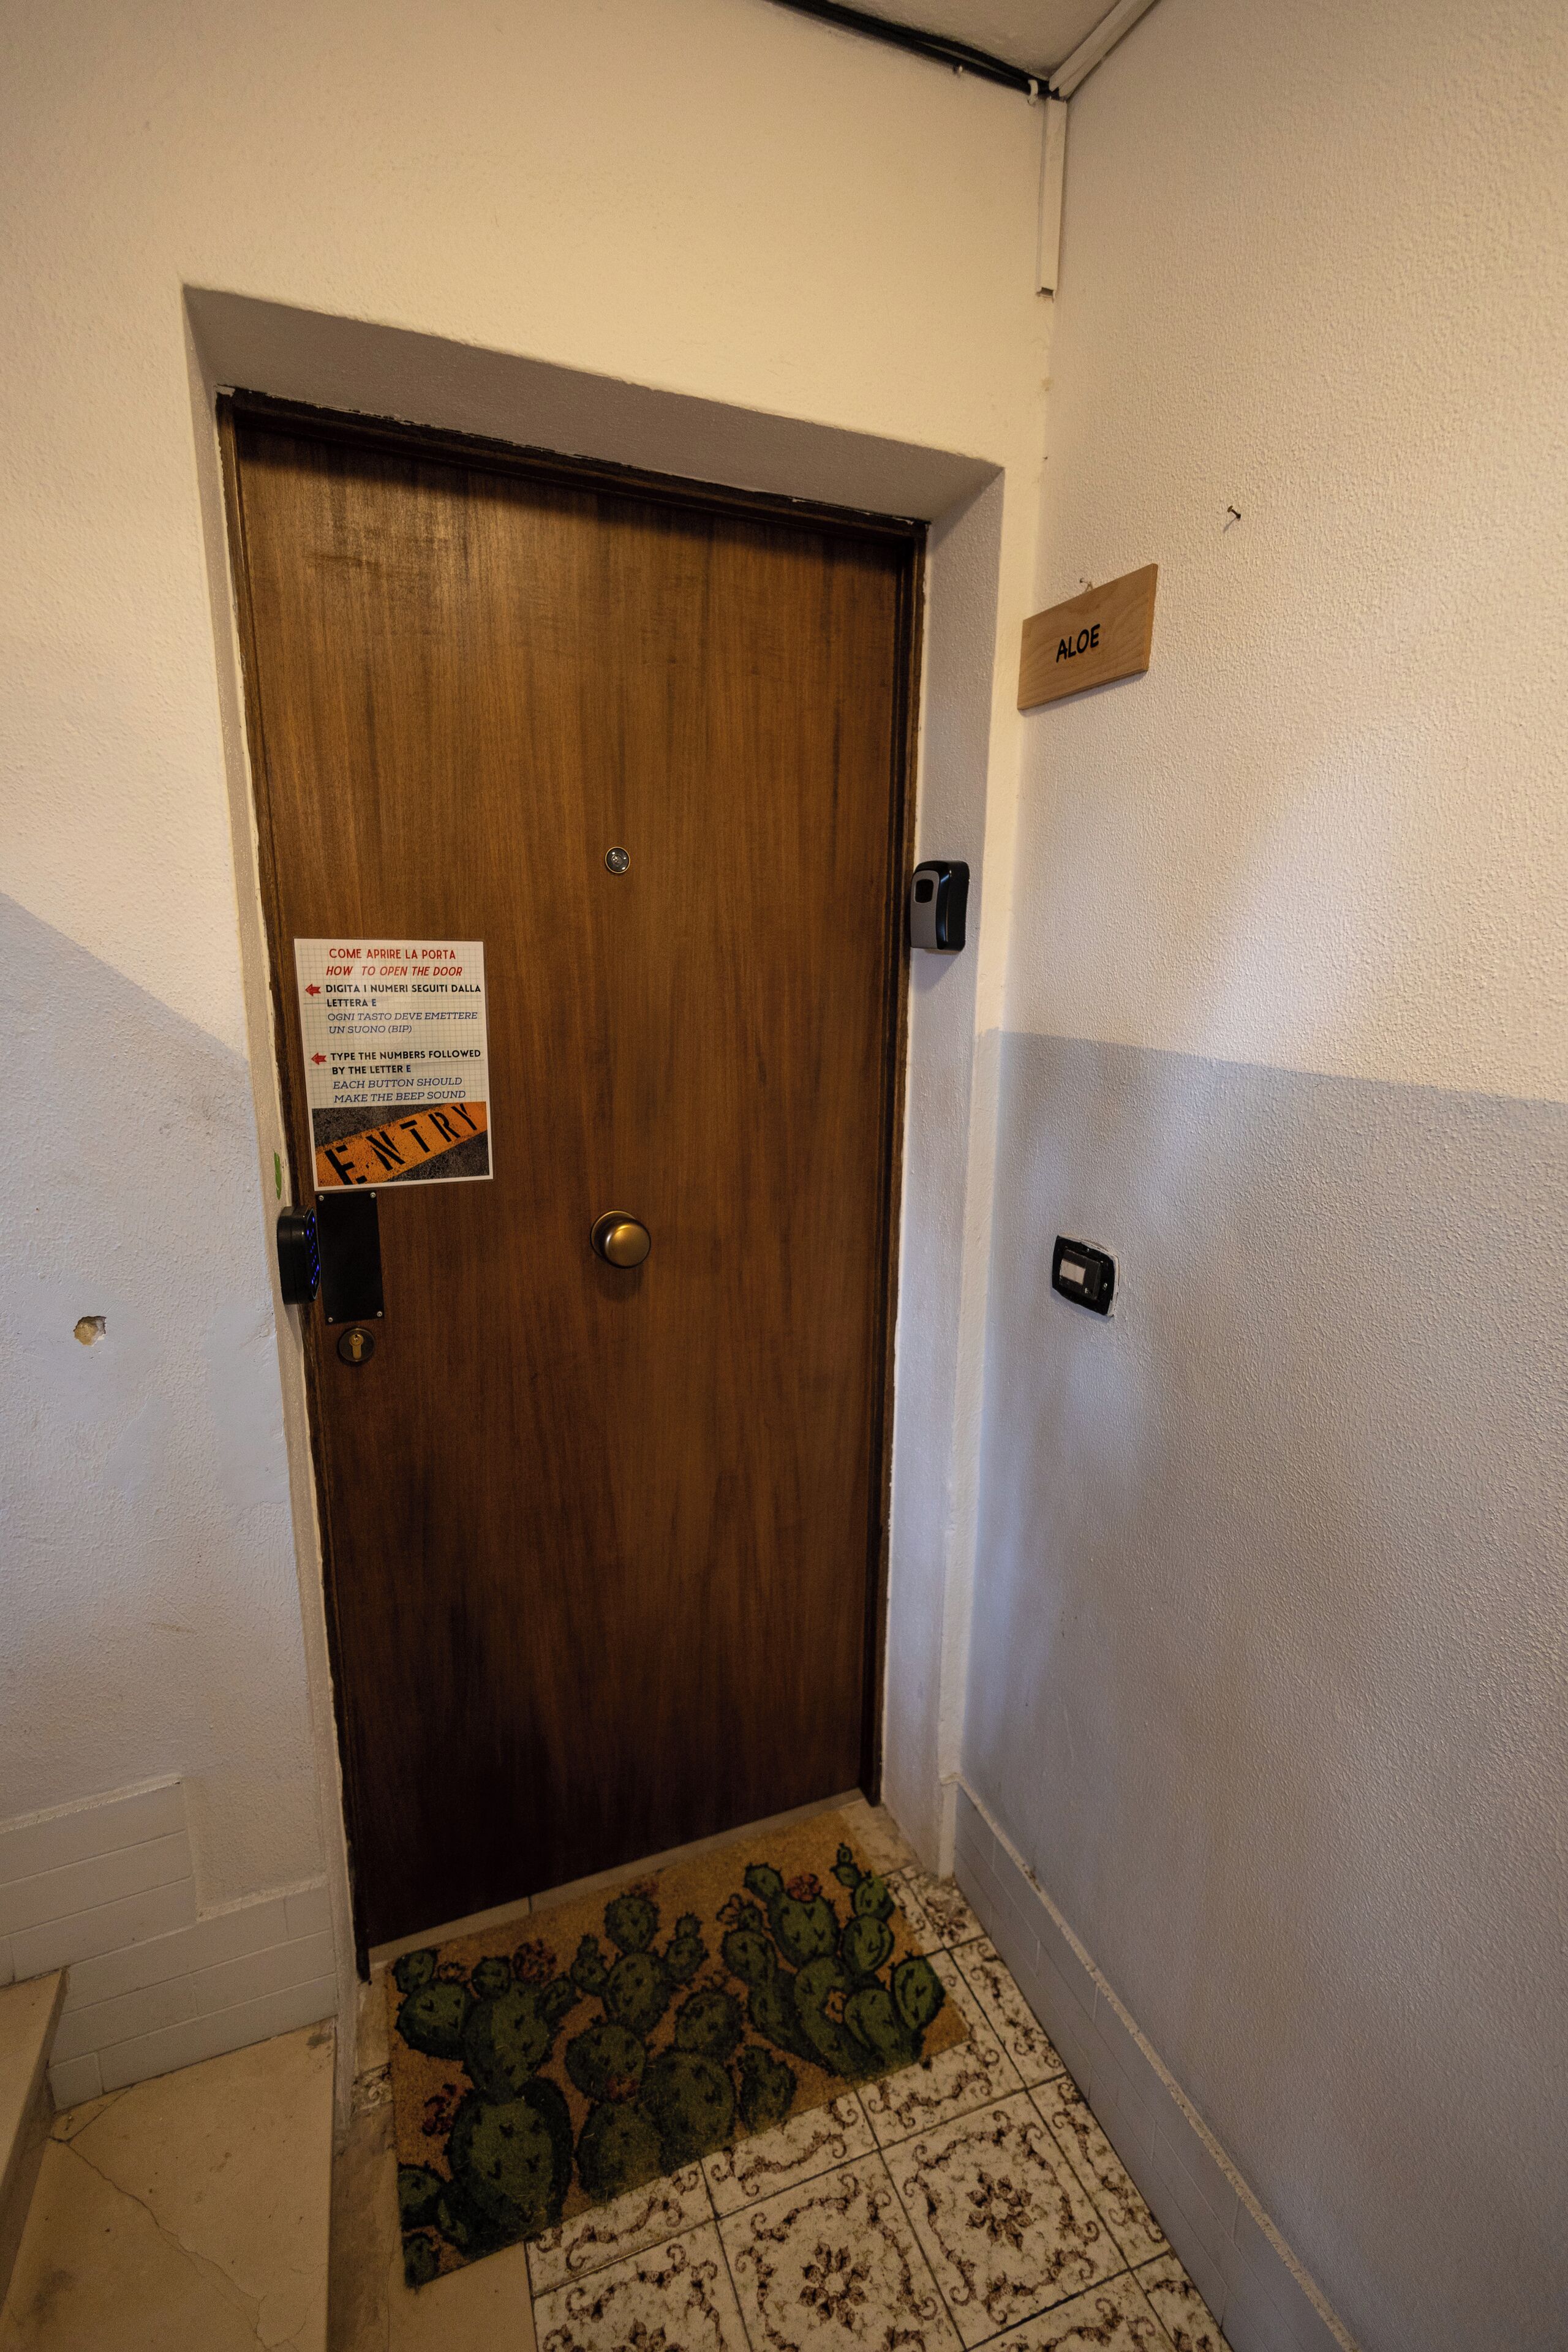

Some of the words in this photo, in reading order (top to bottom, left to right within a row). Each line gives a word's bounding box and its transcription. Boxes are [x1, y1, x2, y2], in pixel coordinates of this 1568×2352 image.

[1056, 624, 1101, 663] ALOE
[329, 949, 362, 959] COME
[367, 949, 401, 959] APRIRE
[405, 949, 418, 959] LA
[422, 950, 456, 959] PORTA
[326, 966, 353, 976] HOW
[362, 966, 375, 976] TO
[380, 967, 407, 976] OPEN
[412, 967, 430, 976] THE
[433, 967, 462, 976] DOOR
[412, 984, 448, 993] SEGUITI
[388, 1025, 412, 1034] (BIP)
[429, 1050, 481, 1058] FOLLOWED
[370, 1065, 403, 1074] LETTER
[333, 1080, 365, 1089] EACH
[368, 1079, 414, 1088] BUTTON
[417, 1077, 462, 1086] SHOULD
[334, 1094, 368, 1103] MAKE
[396, 1092, 424, 1101] BEEP
[427, 1090, 466, 1099] SOUND
[325, 1103, 477, 1185] ENTRY
